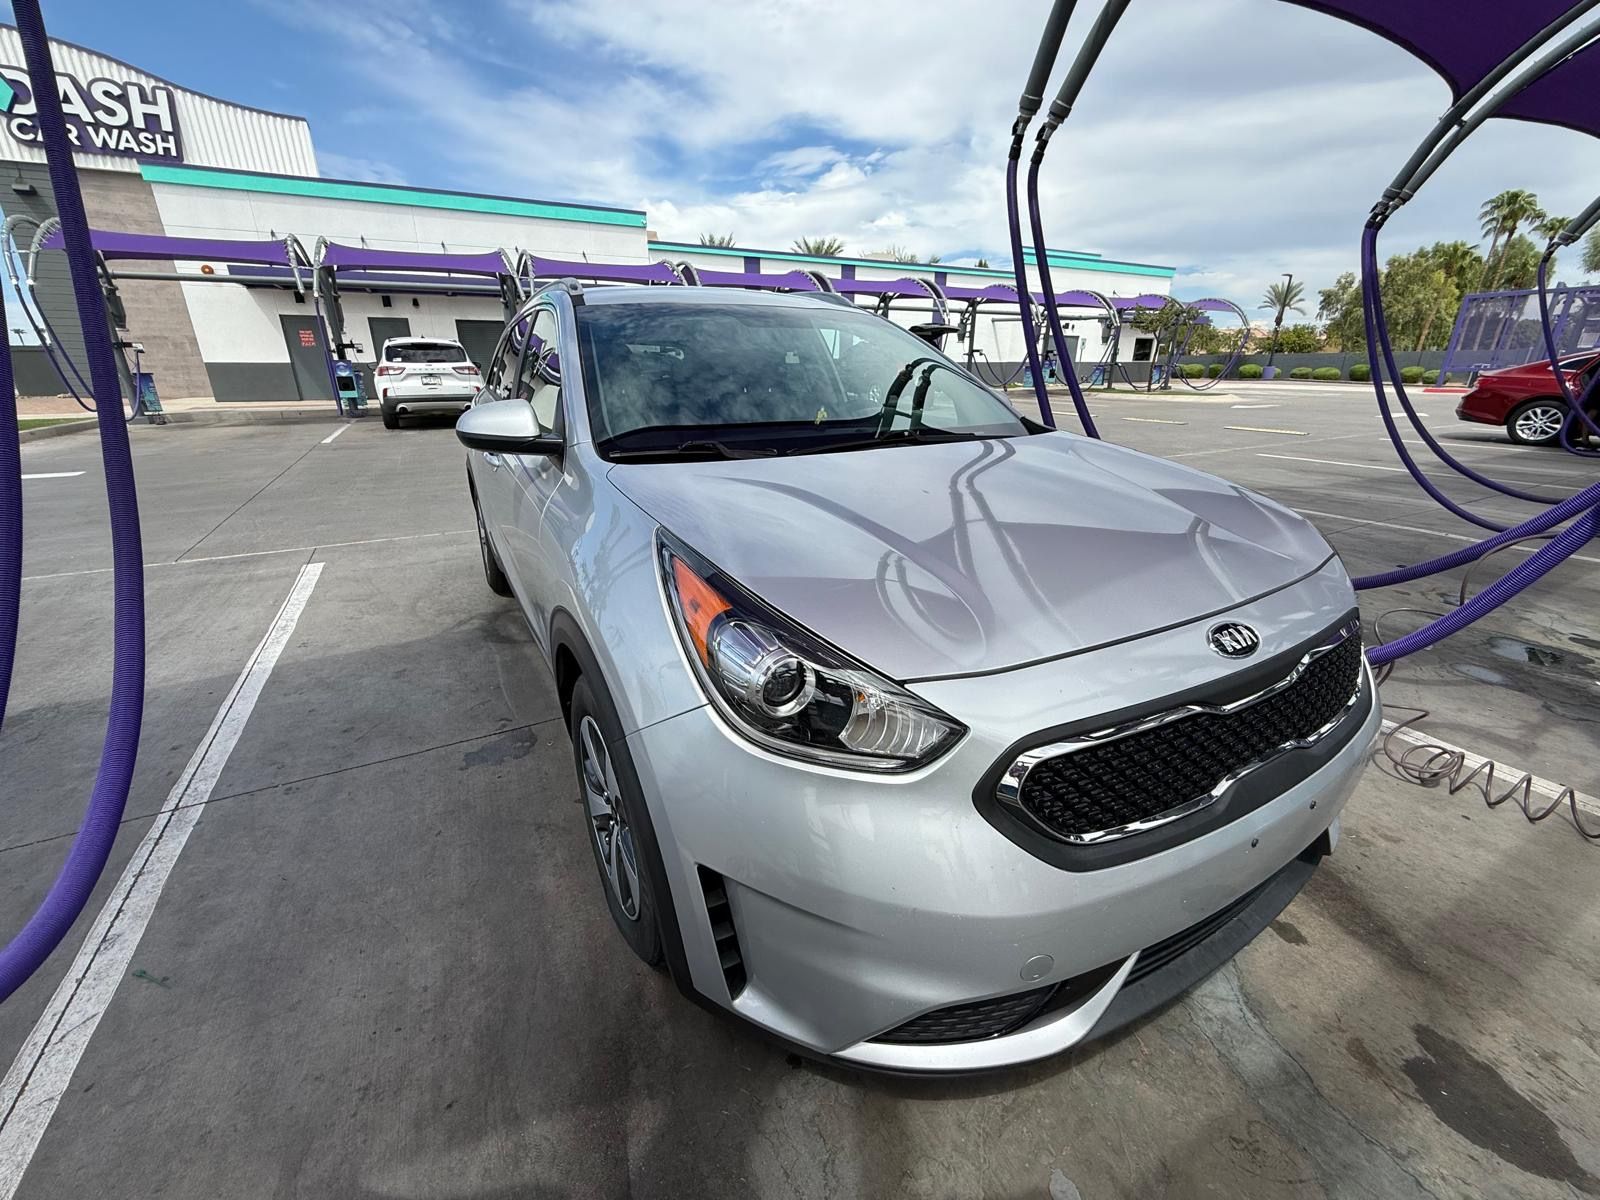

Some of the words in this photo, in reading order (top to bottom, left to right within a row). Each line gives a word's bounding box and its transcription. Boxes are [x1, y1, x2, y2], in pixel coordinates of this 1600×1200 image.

[10, 117, 81, 146] CR
[86, 125, 177, 157] WASH
[1214, 626, 1257, 652] KIA
